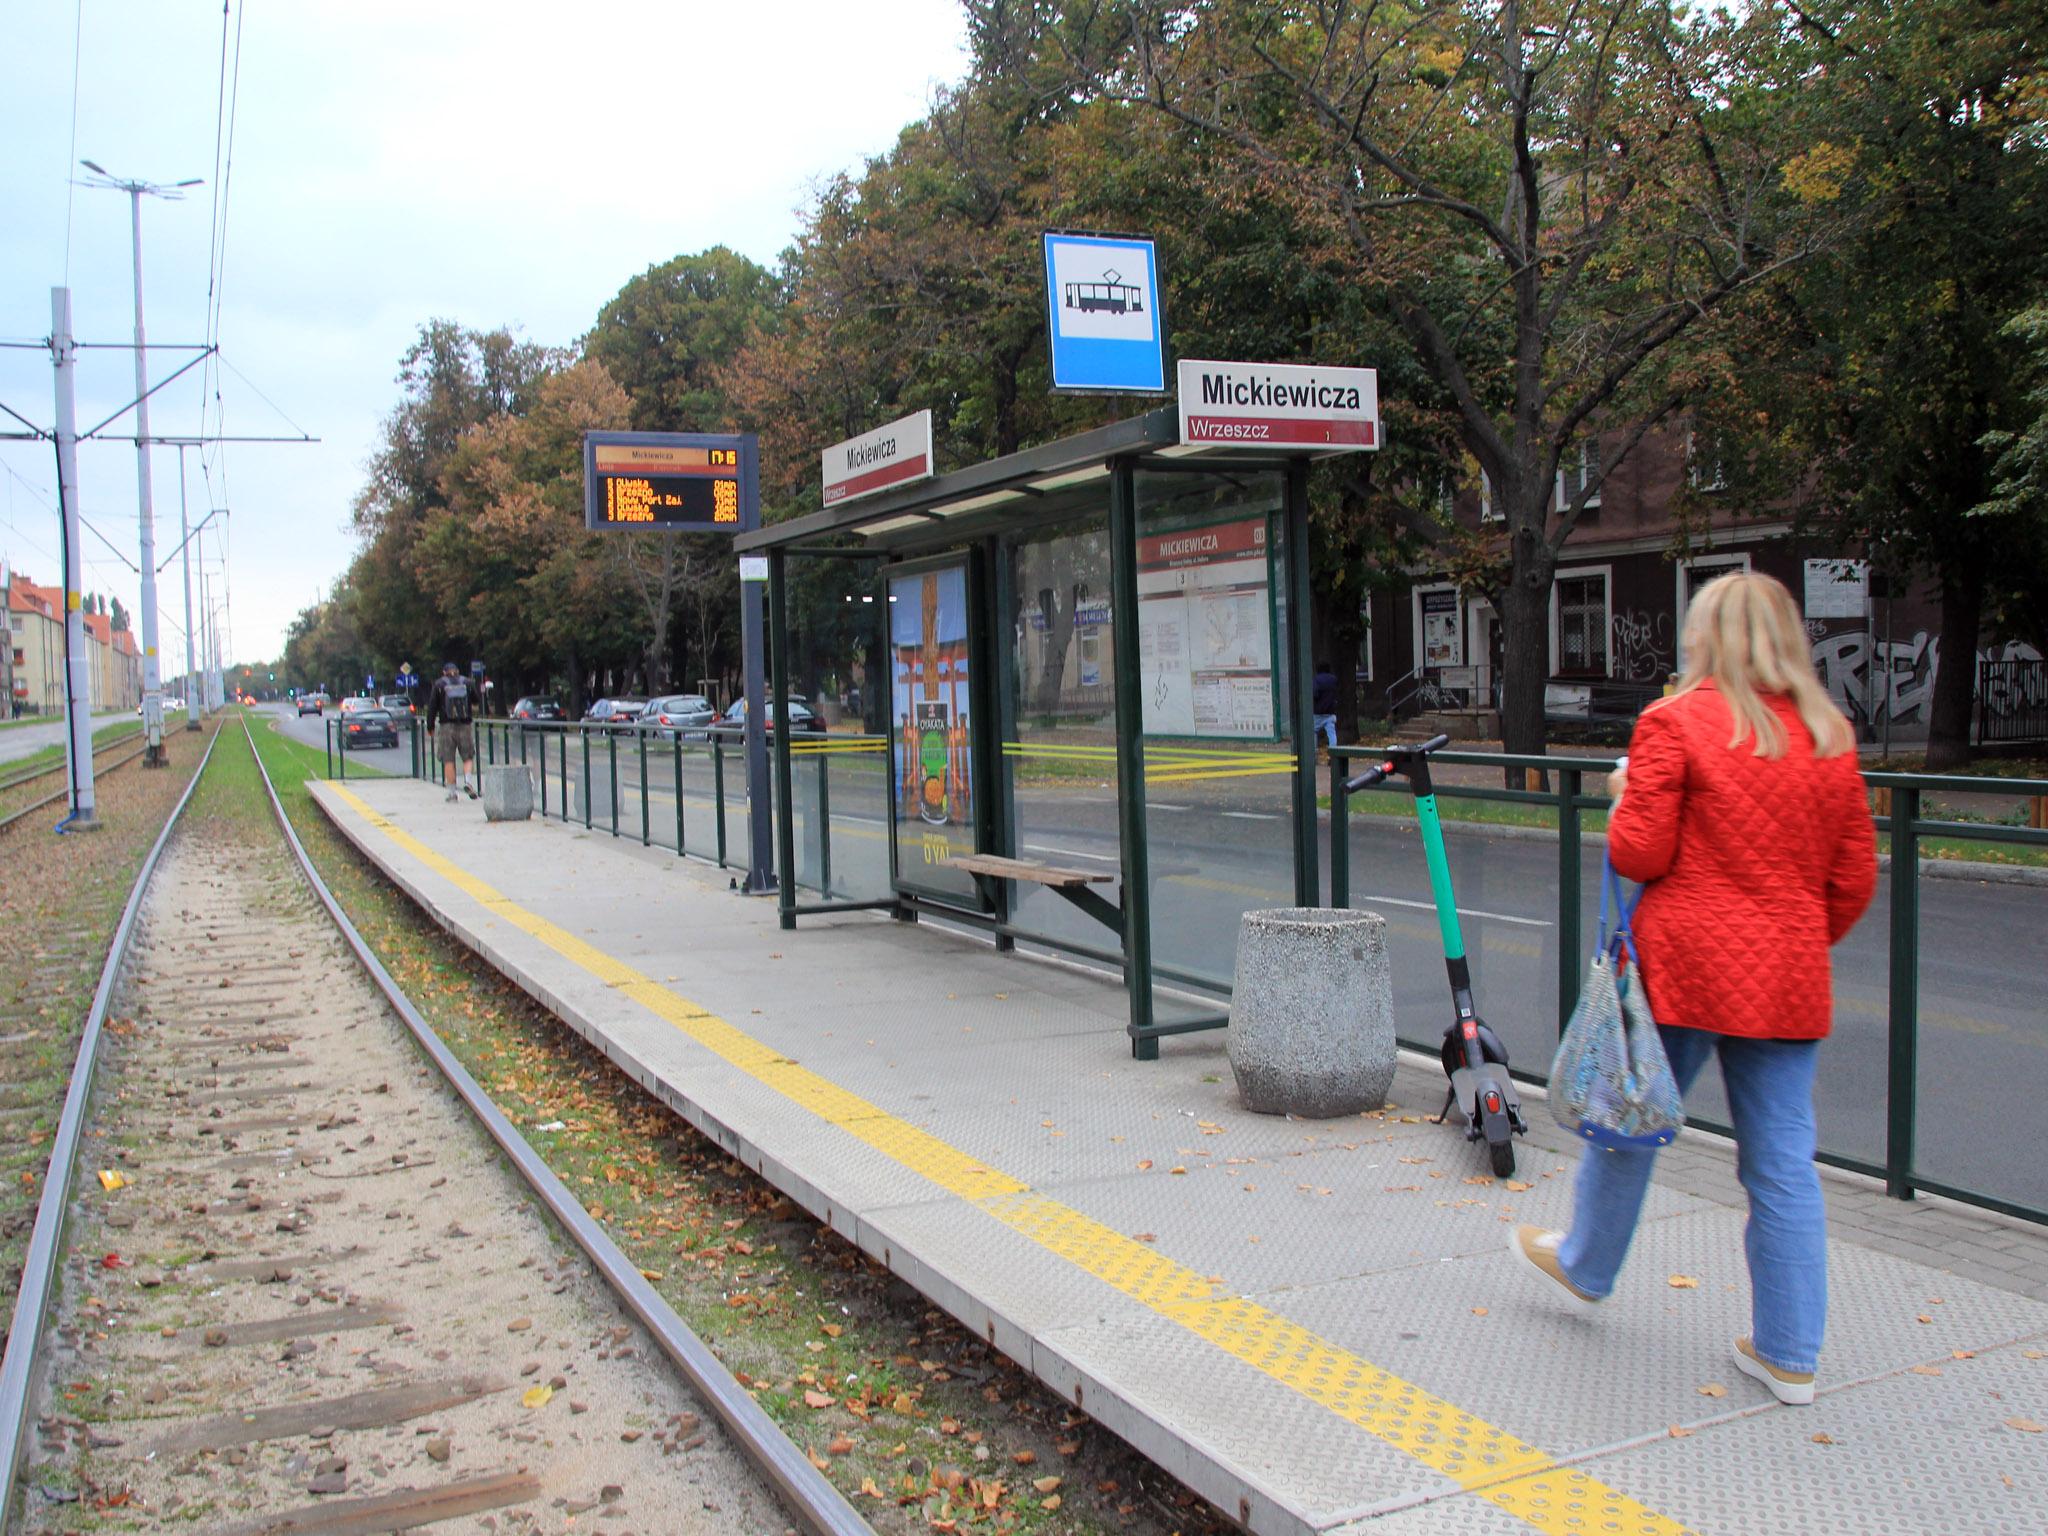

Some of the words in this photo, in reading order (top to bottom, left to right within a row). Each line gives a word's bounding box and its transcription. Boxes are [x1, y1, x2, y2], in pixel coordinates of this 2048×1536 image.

[1202, 374, 1361, 410] Mickiewicza
[1191, 419, 1270, 439] Wrzeszcz
[631, 450, 674, 460] Mickiewicza
[847, 437, 896, 471] Mickiewicza
[1160, 534, 1218, 557] MICKIEWICZA
[920, 719, 945, 730] OYAKATA
